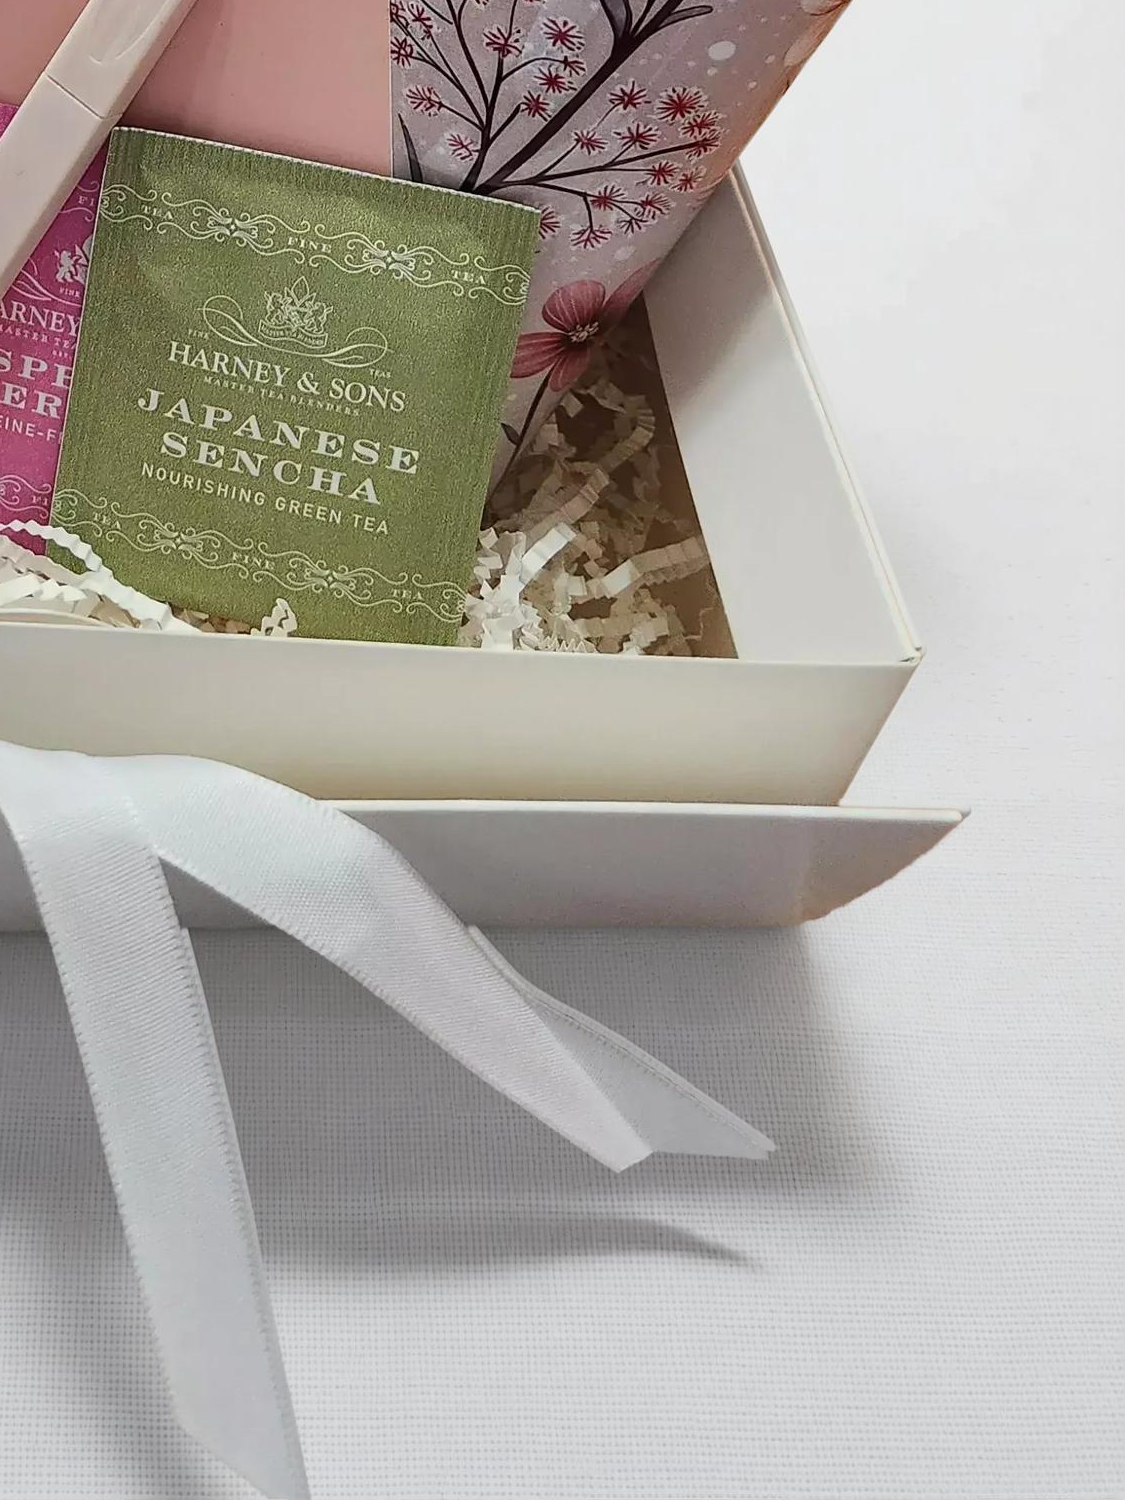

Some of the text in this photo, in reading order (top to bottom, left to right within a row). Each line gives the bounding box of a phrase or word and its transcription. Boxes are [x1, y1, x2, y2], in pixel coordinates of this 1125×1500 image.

[78, 195, 95, 207] FI
[140, 204, 486, 285] TEA FINE TEA
[168, 341, 406, 412] HARNEY & SONS
[204, 376, 254, 395] MASTER
[261, 387, 284, 401] TEA
[137, 387, 420, 474] JAPANESE
[141, 462, 389, 535] NOURISHING GREEN TEA
[161, 431, 381, 506] SENCHA
[92, 511, 123, 531] TEA
[391, 587, 424, 602] TEA
